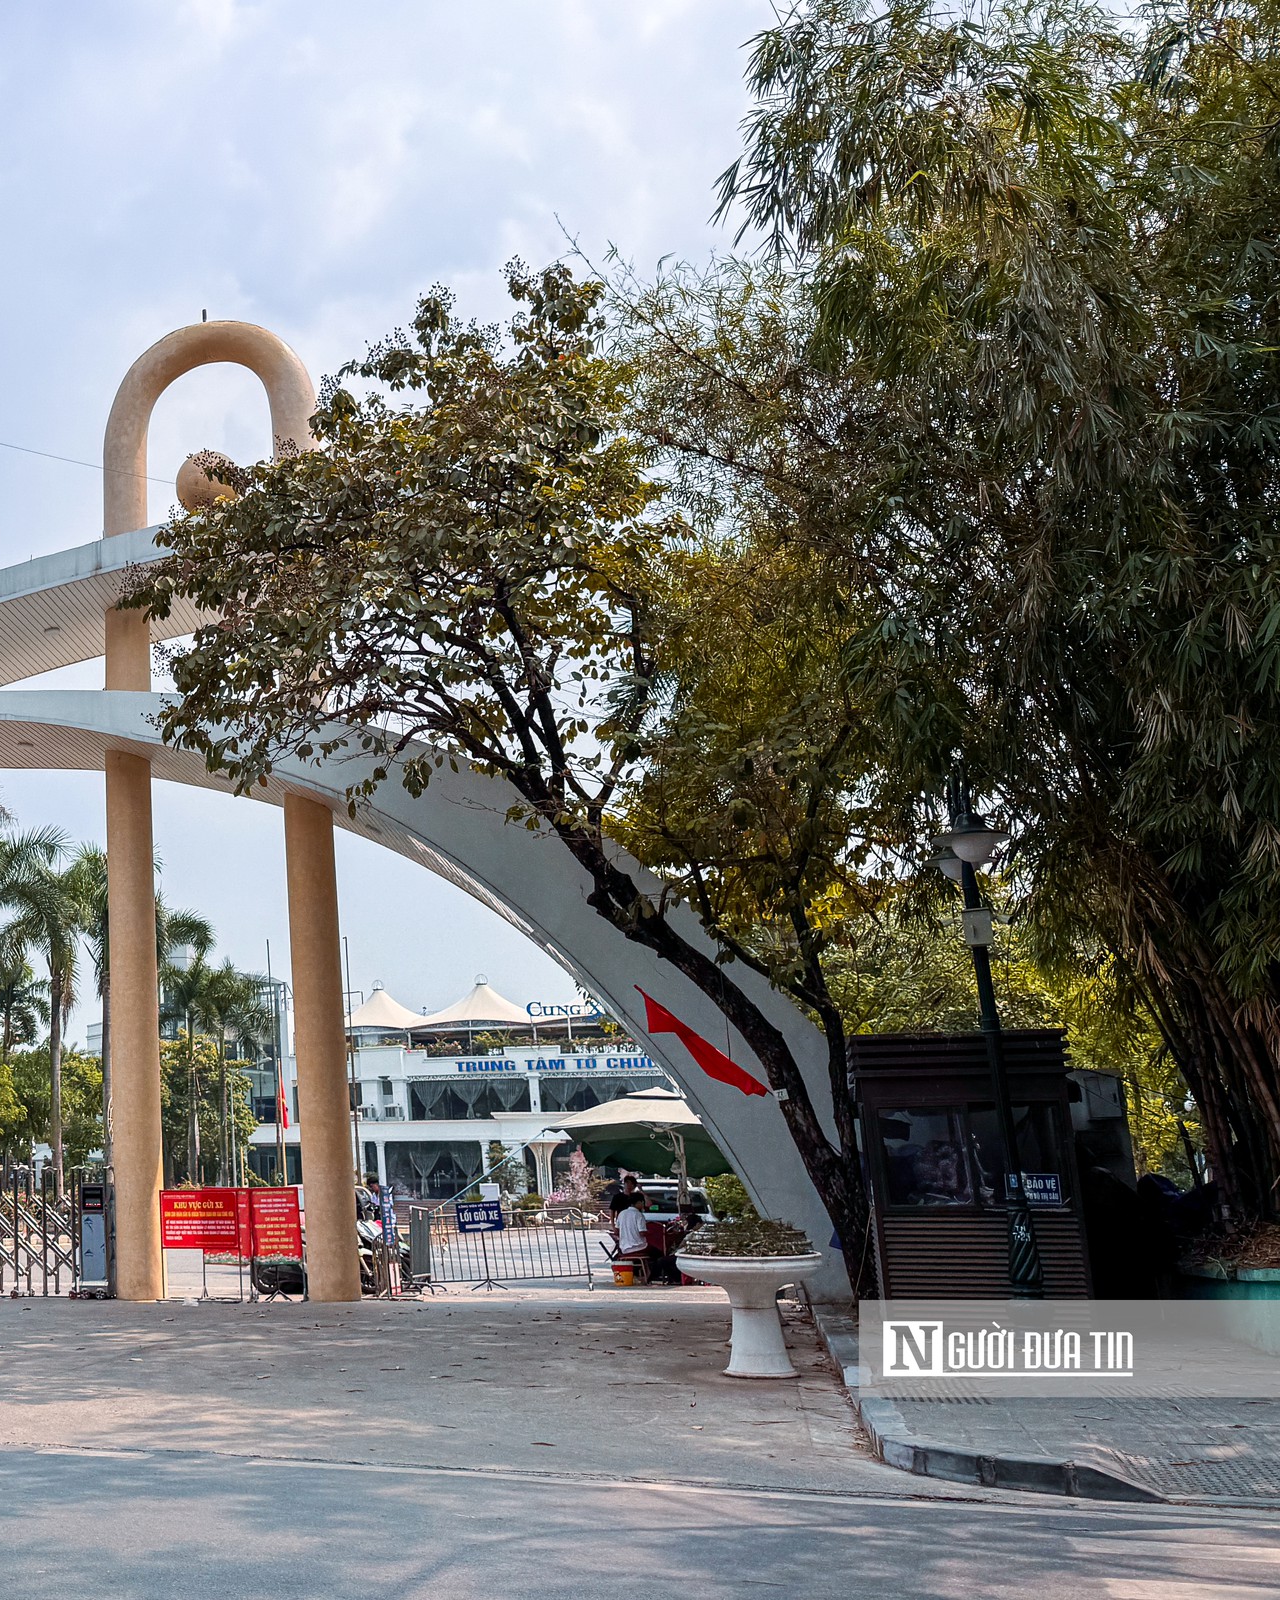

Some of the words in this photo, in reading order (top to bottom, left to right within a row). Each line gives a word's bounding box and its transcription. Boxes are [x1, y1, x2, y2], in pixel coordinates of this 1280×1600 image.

[455, 1060, 516, 1073] TRUNG
[524, 1056, 566, 1071] TÂM
[1026, 1176, 1044, 1189] BẢO
[174, 1201, 187, 1209] KHU
[215, 1201, 224, 1209] XE
[459, 1208, 472, 1222] LỐI
[473, 1208, 487, 1221] GỬI
[488, 1210, 499, 1220] XE
